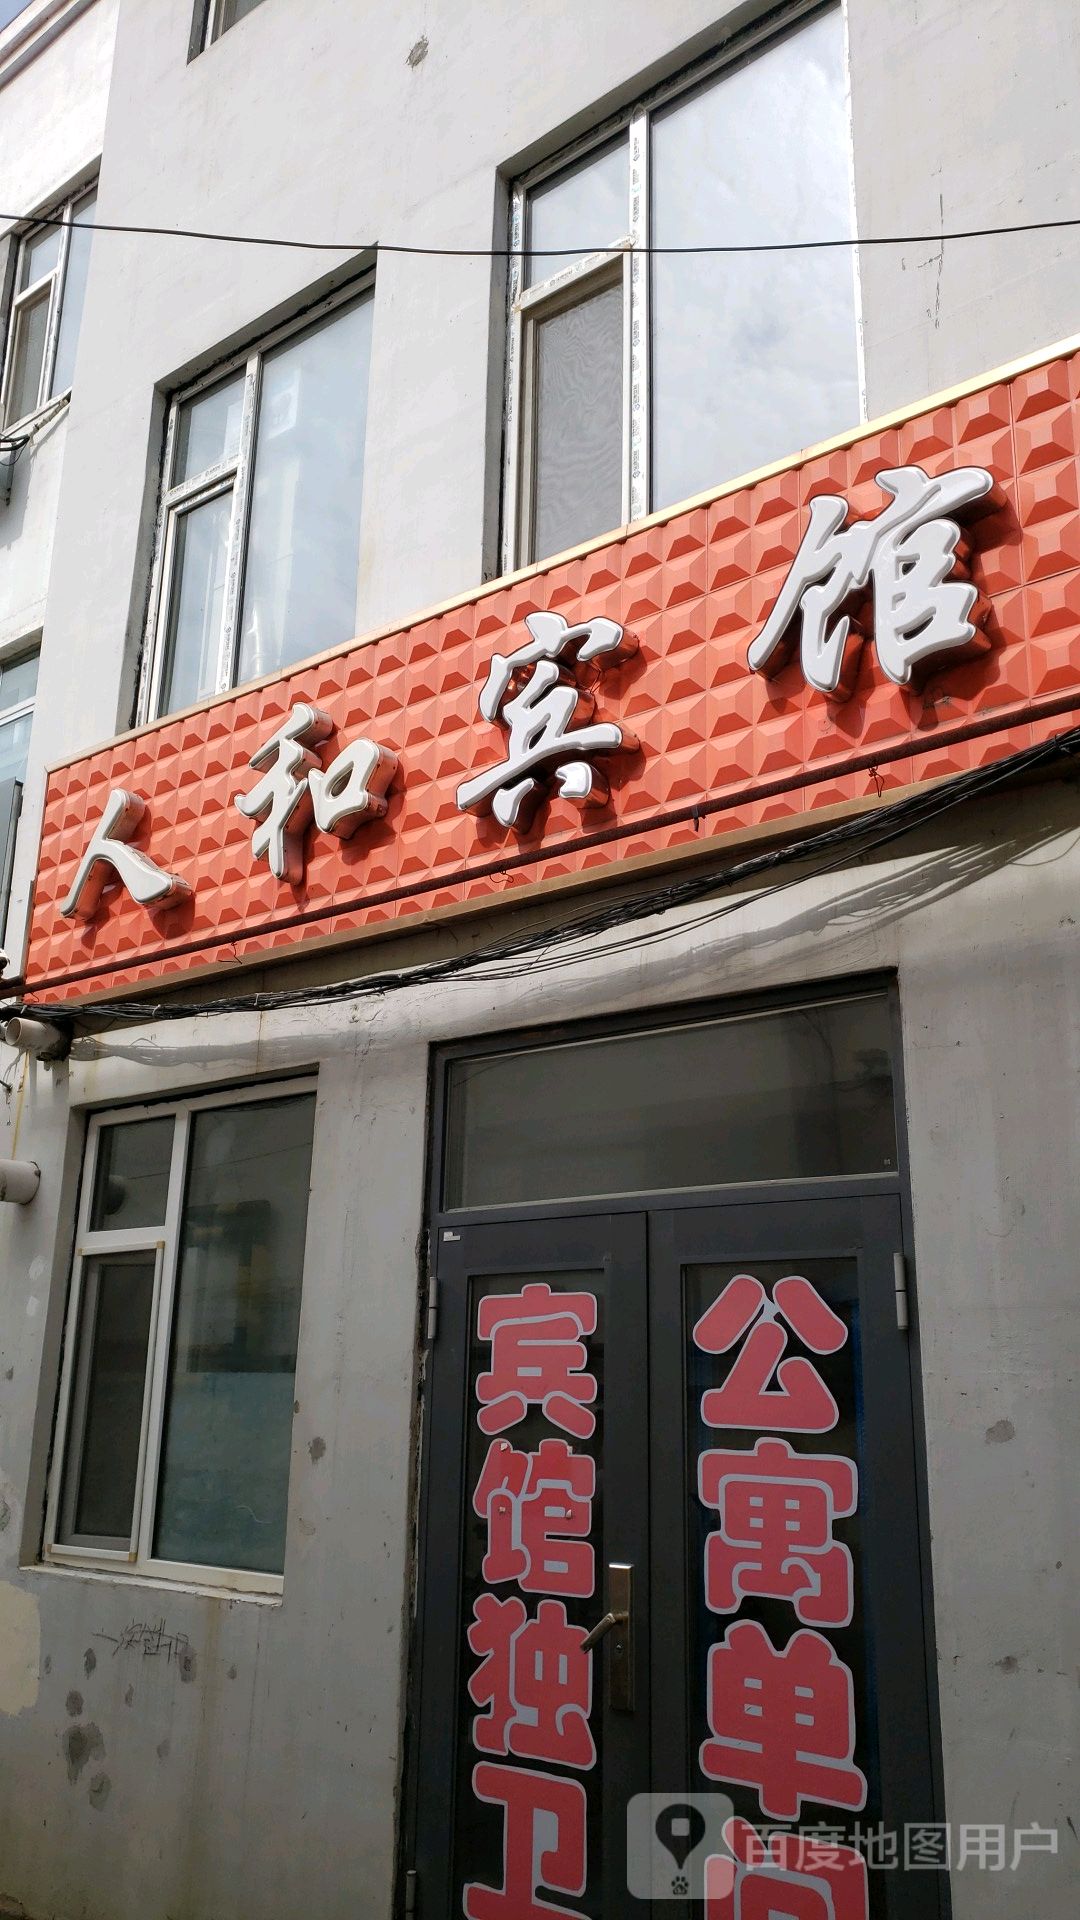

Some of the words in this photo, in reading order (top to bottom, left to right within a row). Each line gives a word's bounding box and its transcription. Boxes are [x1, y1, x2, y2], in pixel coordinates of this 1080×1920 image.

[59, 465, 993, 920] 人和宾馆
[463, 1284, 597, 1920] 宾馆独卫
